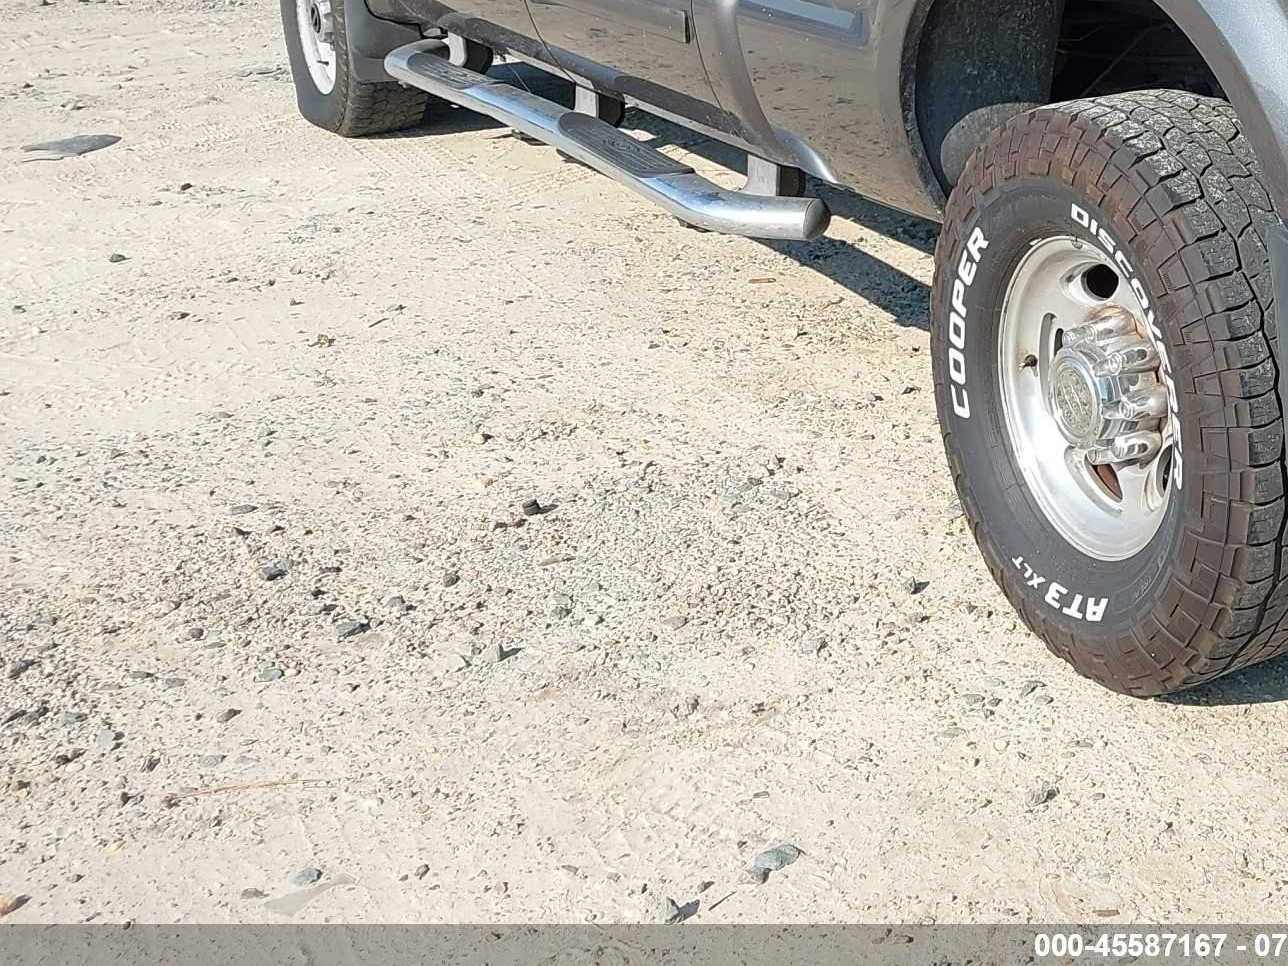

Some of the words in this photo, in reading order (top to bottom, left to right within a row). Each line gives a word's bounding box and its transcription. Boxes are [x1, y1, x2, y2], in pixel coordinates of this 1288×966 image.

[948, 226, 990, 420] COOPER
[1011, 554, 1046, 588] XLT
[1043, 582, 1108, 622] AT3
